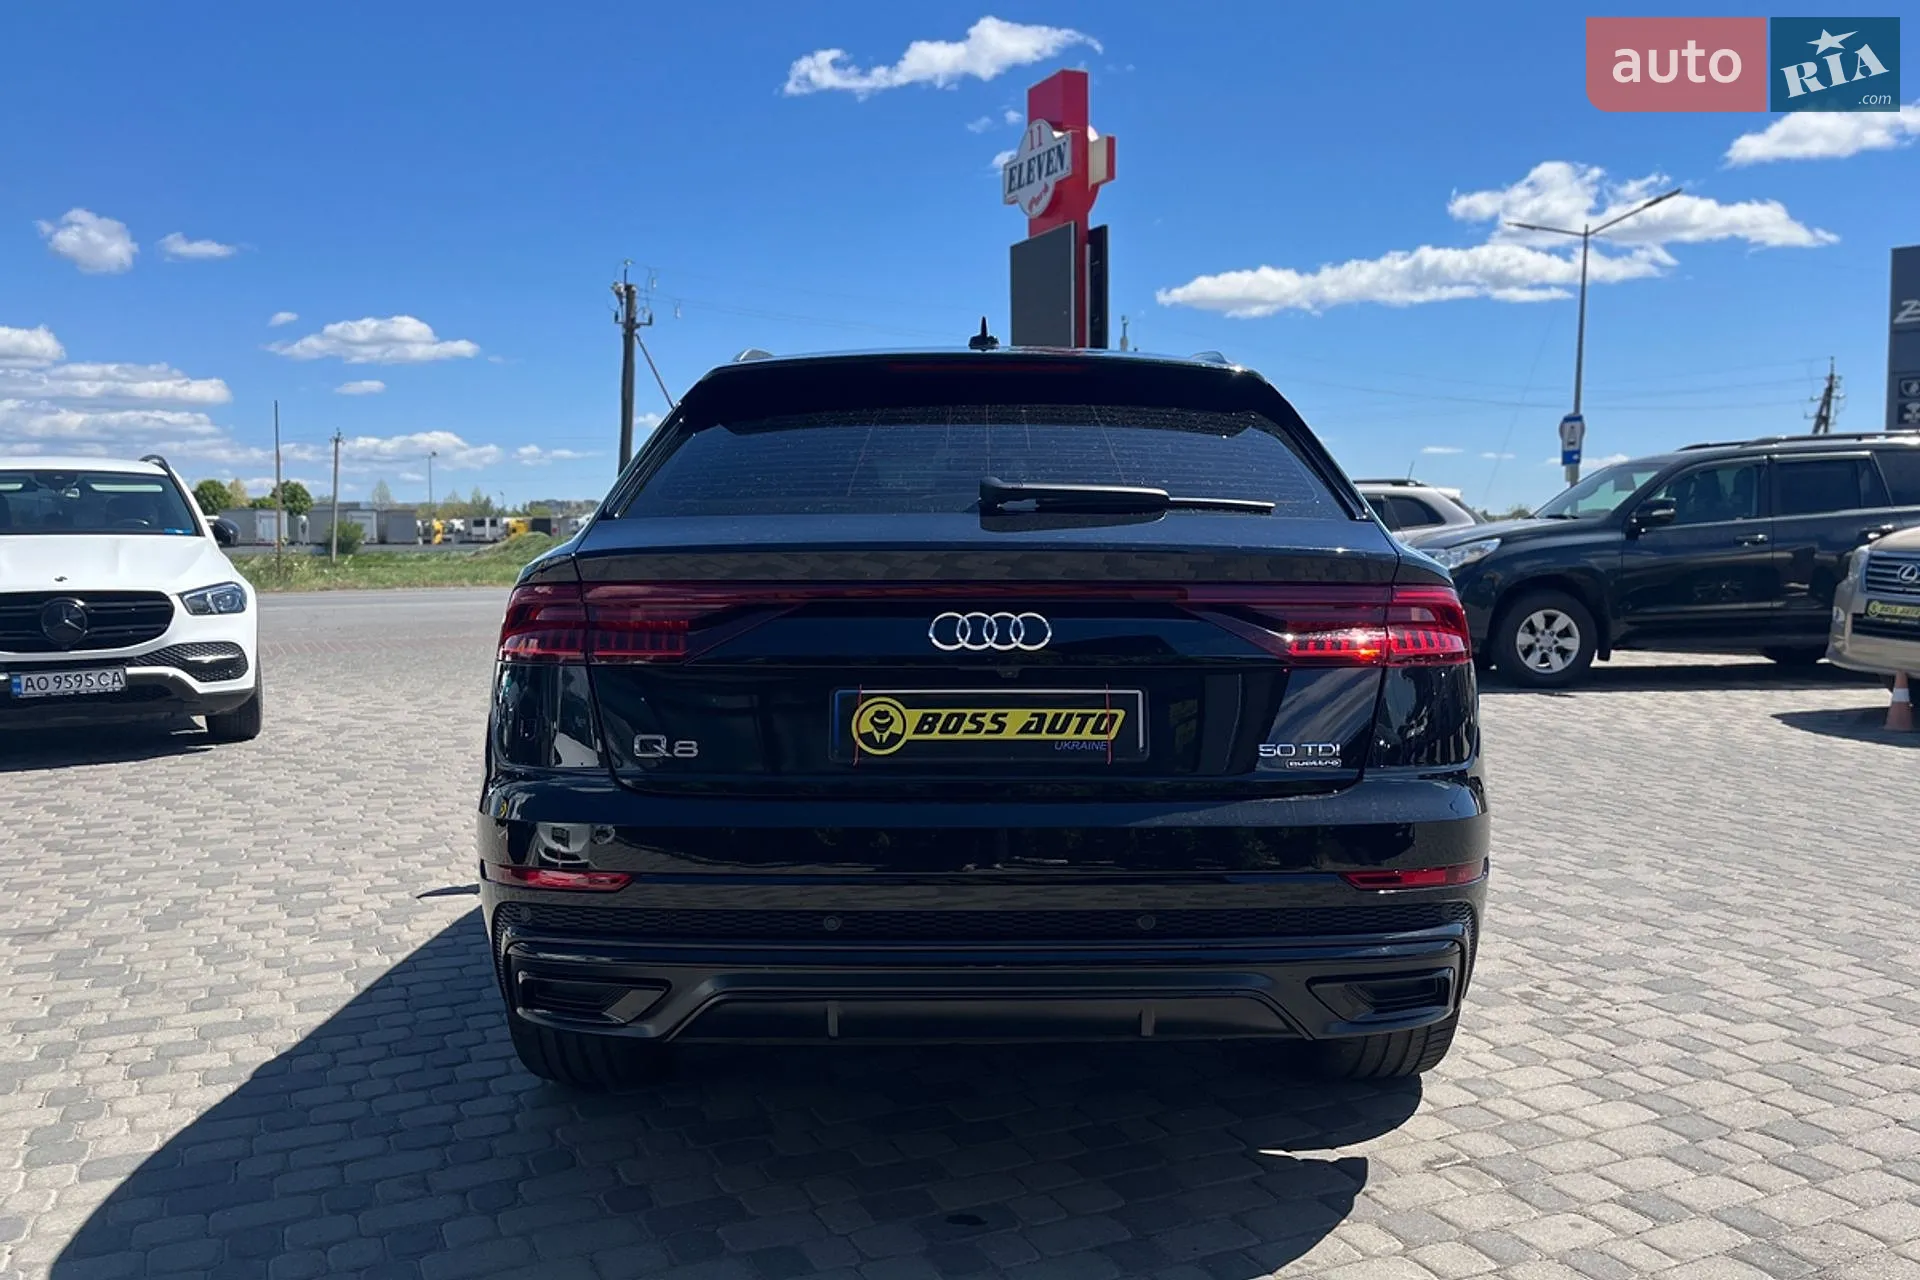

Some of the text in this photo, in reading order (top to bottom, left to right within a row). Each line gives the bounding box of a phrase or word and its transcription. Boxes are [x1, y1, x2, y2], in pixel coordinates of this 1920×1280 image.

[1007, 142, 1067, 194] ELEVEN
[24, 672, 123, 691] AO 9595 CA
[913, 711, 1120, 735] BOSS AUTO
[634, 734, 699, 757] Q8
[1054, 741, 1108, 751] UKRAINE
[1259, 743, 1340, 757] 50 TDI
